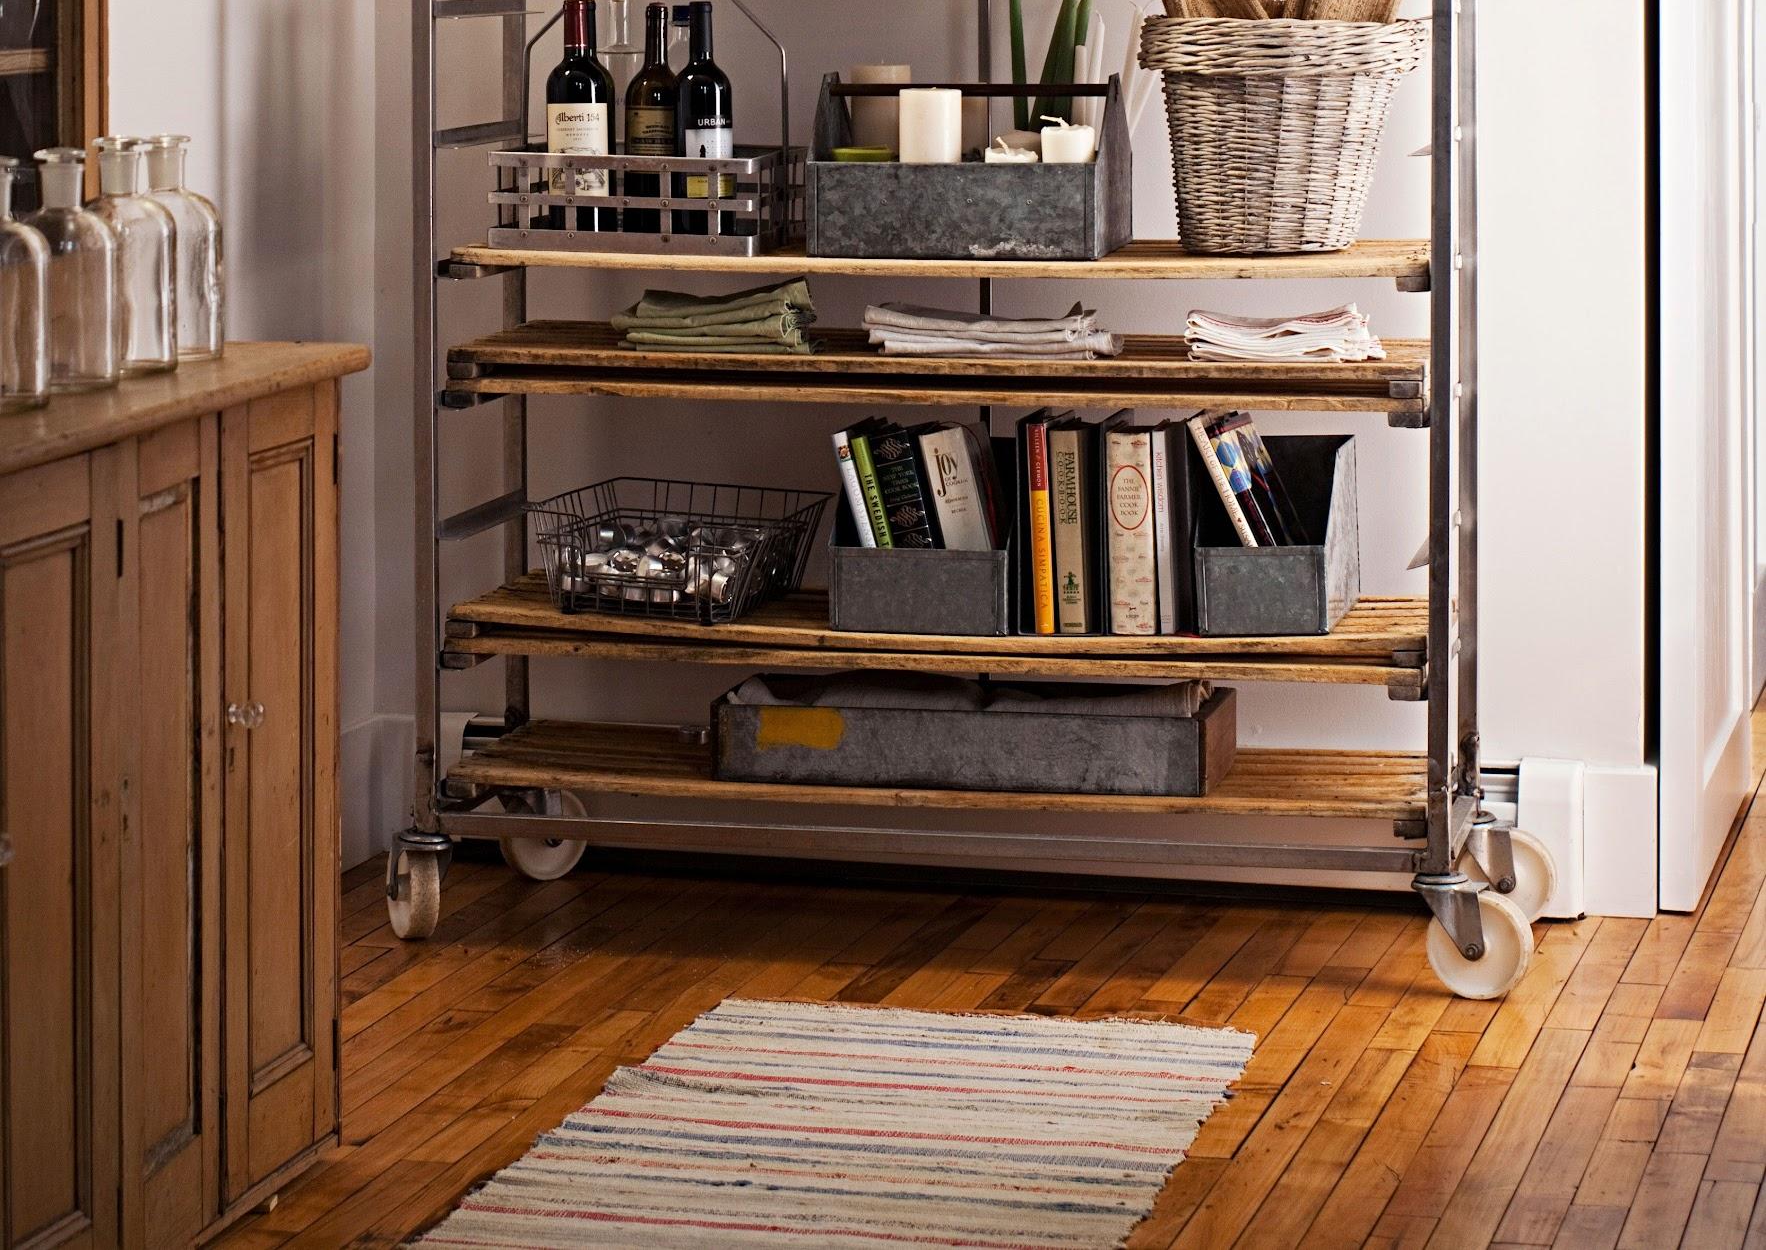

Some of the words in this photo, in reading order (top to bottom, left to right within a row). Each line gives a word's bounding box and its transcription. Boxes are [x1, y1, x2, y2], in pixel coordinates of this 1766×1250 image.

[555, 111, 585, 125] Alberti
[697, 117, 726, 126] URBAN
[865, 473, 876, 492] THE
[933, 447, 959, 498] joy
[1155, 452, 1163, 480] kitchen
[1065, 451, 1078, 525] FARMHOUSE
[1156, 482, 1164, 513] wisdom
[869, 495, 888, 537] SWEDISH
[1036, 498, 1046, 542] CUCINA
[1038, 548, 1049, 608] SIMPATICA
